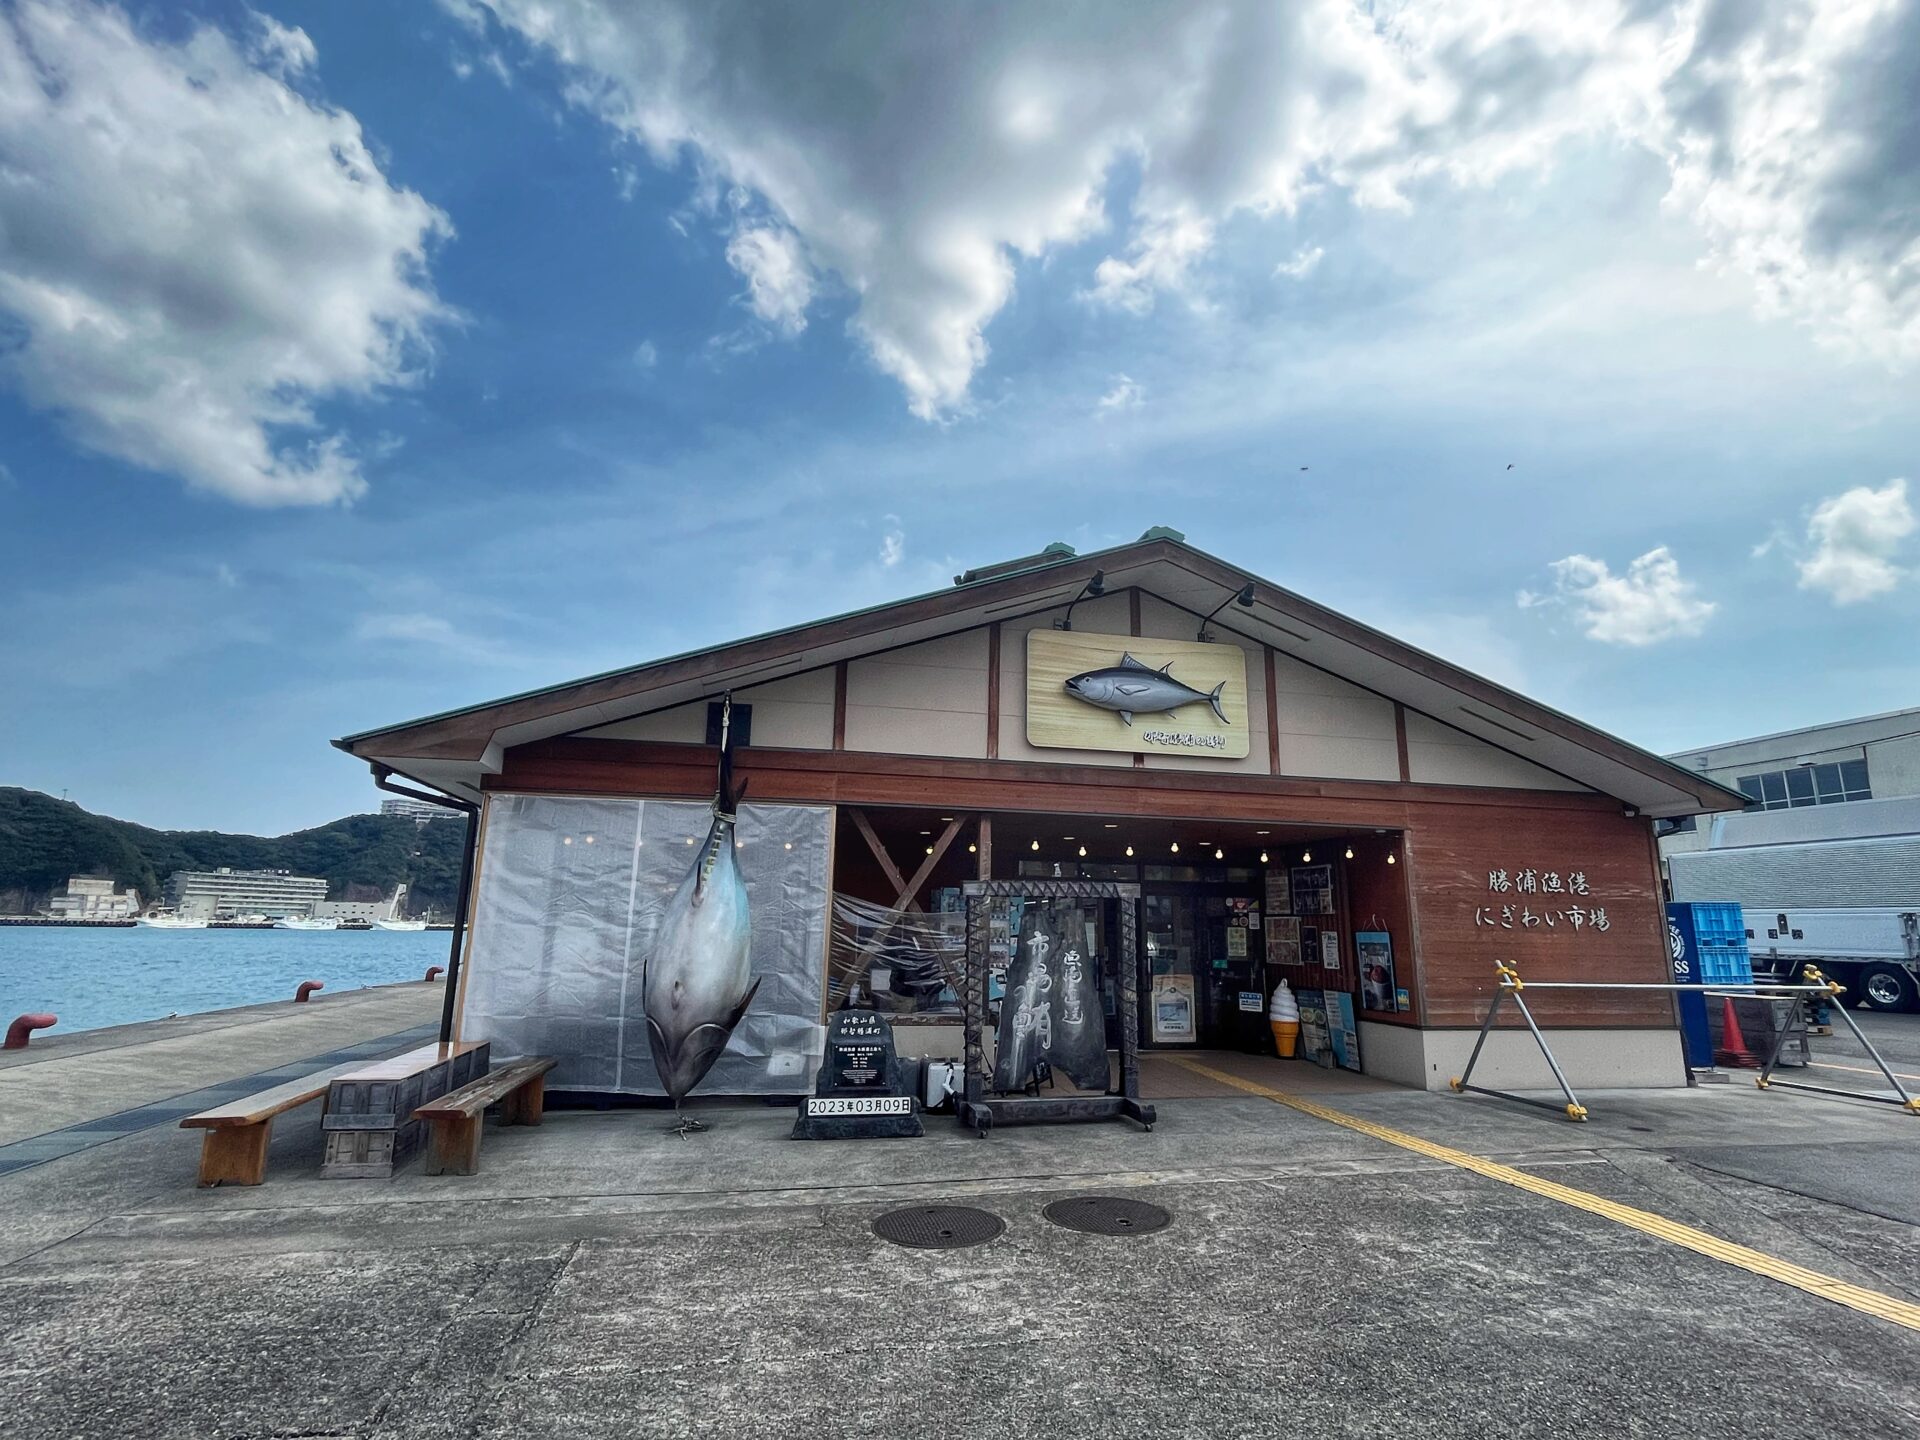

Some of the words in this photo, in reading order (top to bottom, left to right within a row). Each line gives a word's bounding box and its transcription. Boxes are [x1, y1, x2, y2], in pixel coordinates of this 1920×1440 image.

[1488, 868, 1591, 896] 勝浦漁港
[1475, 904, 1611, 932] にぎわい市場
[840, 1027, 880, 1036] 那智勝浦町
[809, 1099, 910, 1114] 2023年03月09日
